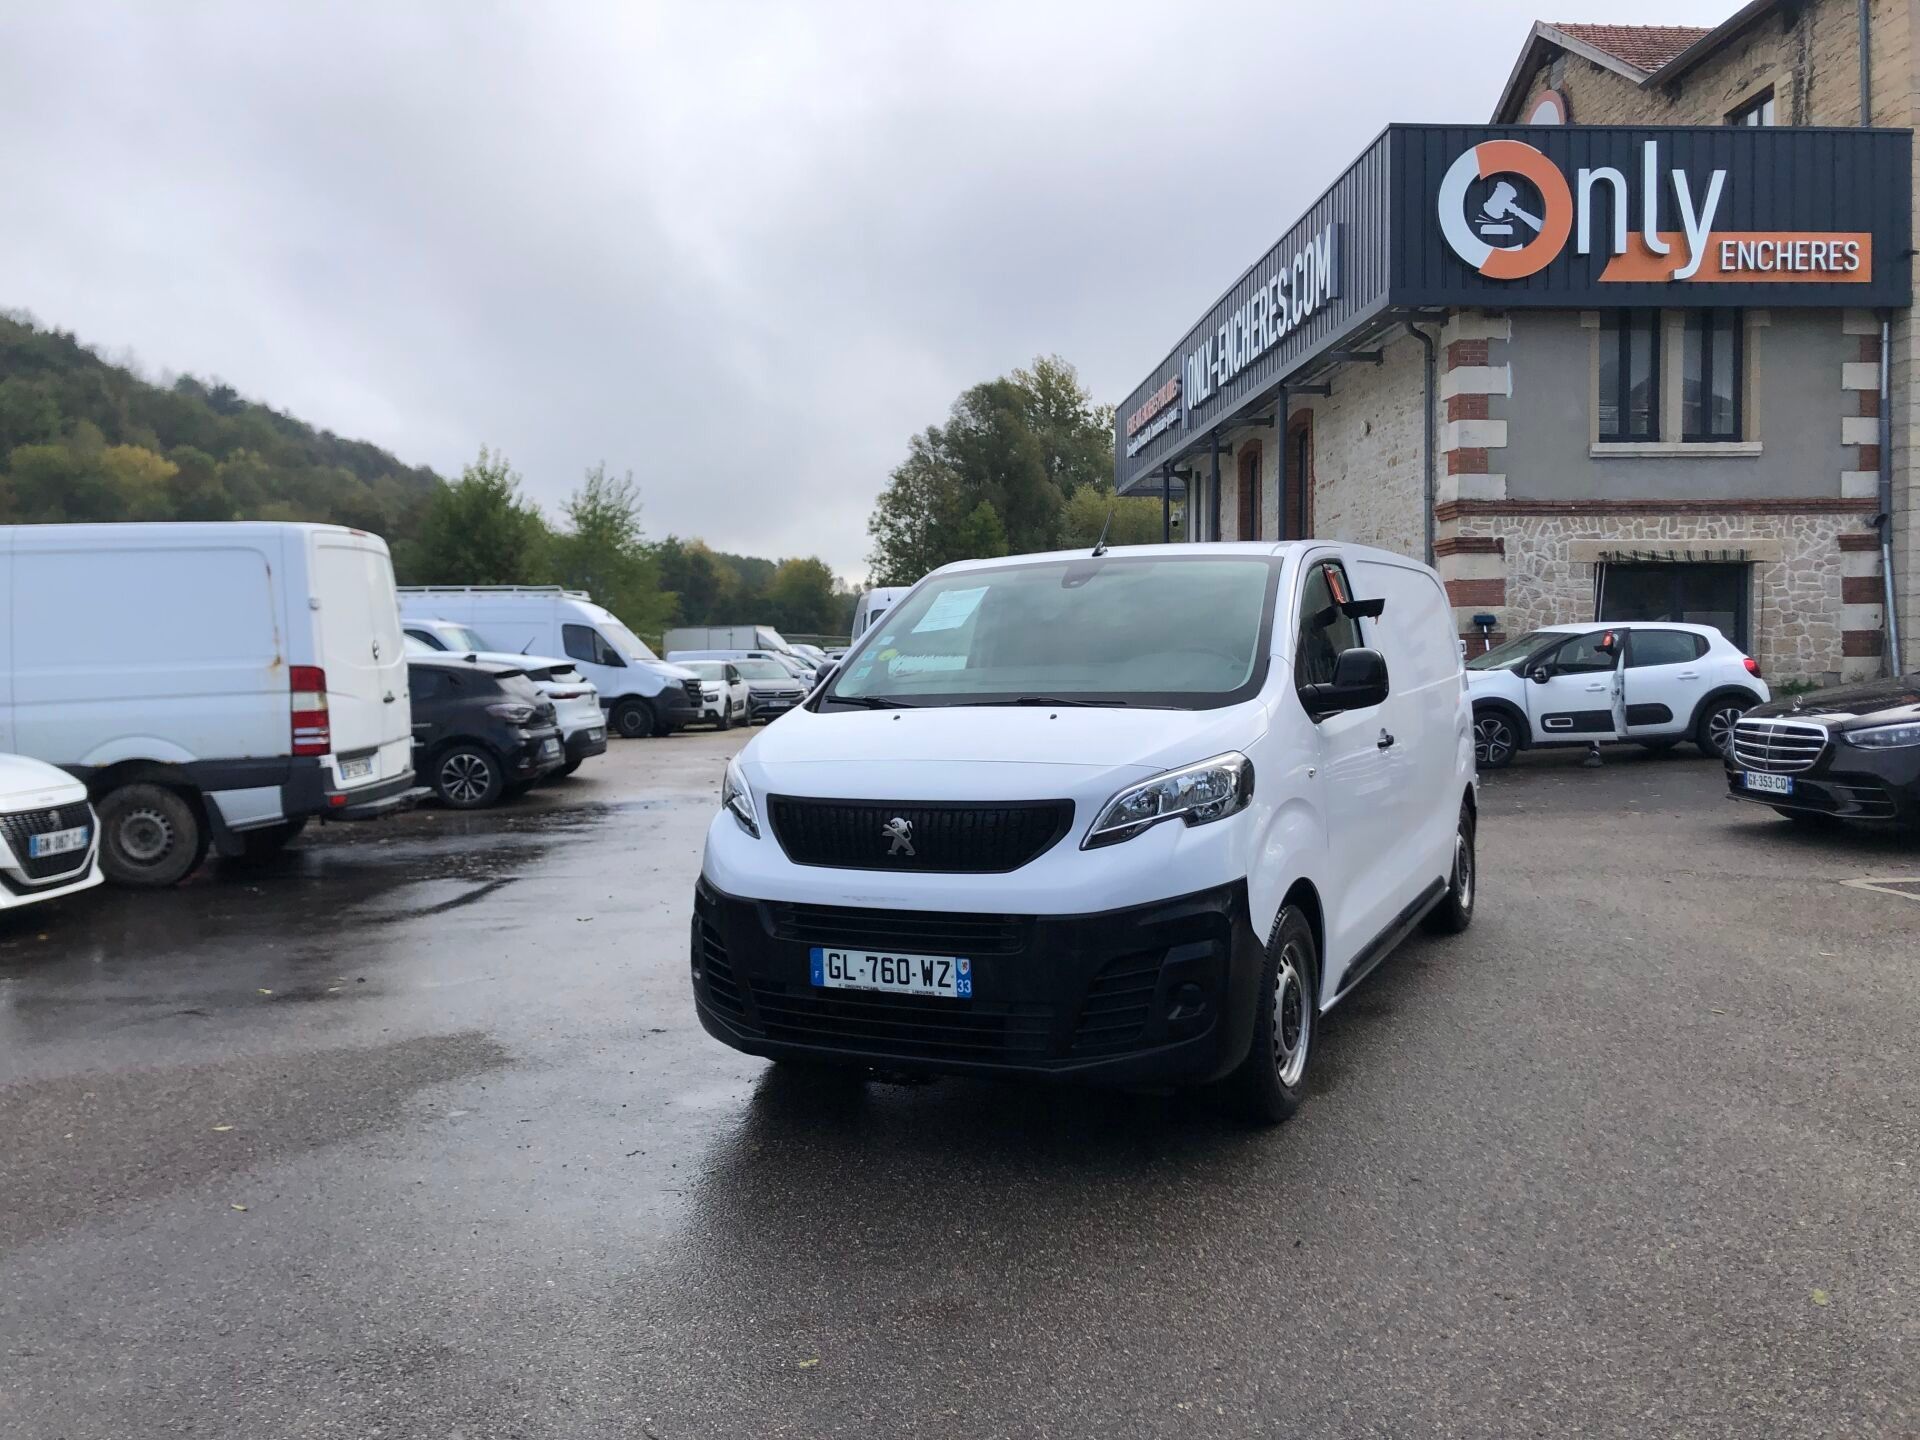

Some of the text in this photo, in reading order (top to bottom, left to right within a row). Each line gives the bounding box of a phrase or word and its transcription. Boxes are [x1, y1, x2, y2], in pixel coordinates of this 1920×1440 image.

[1438, 139, 1727, 280] Only
[1720, 240, 1860, 271] ENCHERES
[1187, 222, 1332, 411] ONLY-ENCHERES.COM
[828, 952, 952, 988] GL-760-WZ
[957, 979, 972, 993] 33
